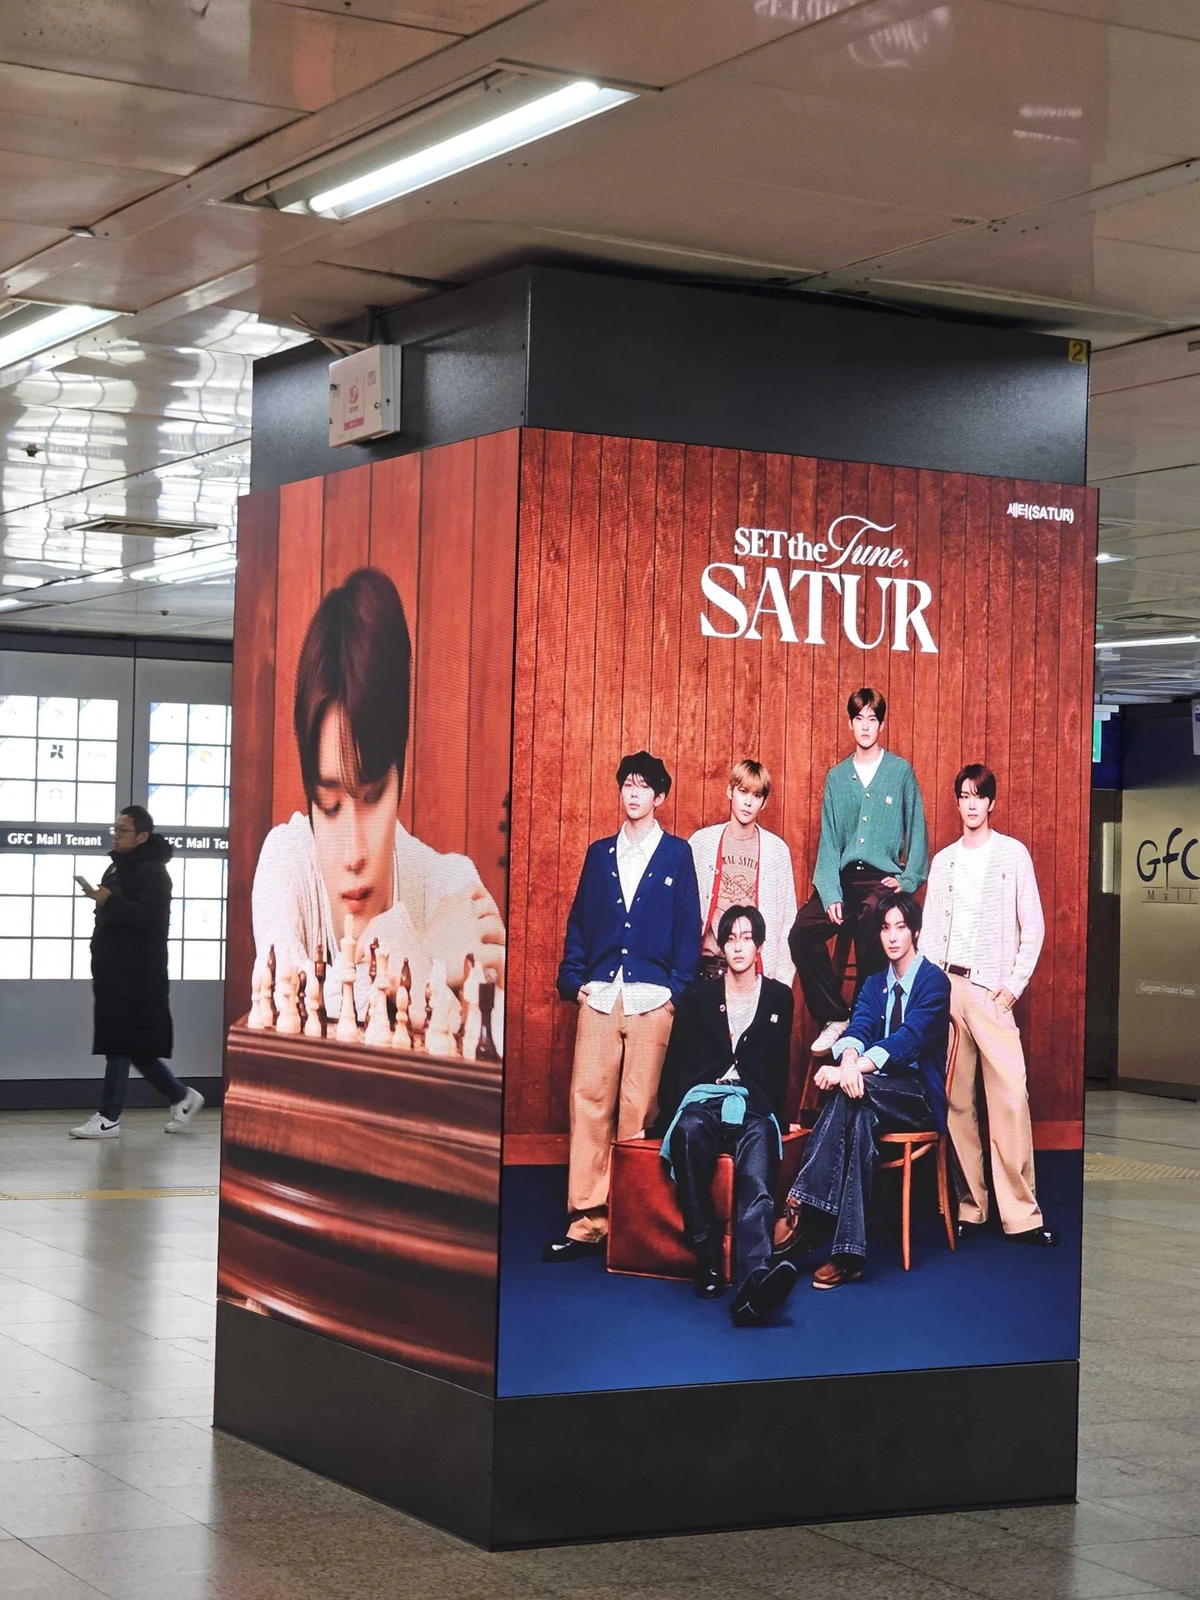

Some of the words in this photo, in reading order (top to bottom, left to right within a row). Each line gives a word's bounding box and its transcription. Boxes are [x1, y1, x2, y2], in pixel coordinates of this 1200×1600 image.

[1071, 341, 1084, 363] 2
[1006, 502, 1075, 524] 세터(SATUR)
[733, 526, 788, 559] SET
[787, 532, 829, 563] the
[700, 562, 939, 654] SATUR
[7, 832, 33, 845] GFC
[36, 833, 61, 845] Mall
[65, 833, 102, 846] Tenant
[164, 836, 183, 848] FC
[186, 837, 210, 849] Mall
[1147, 889, 1192, 902] Mall
